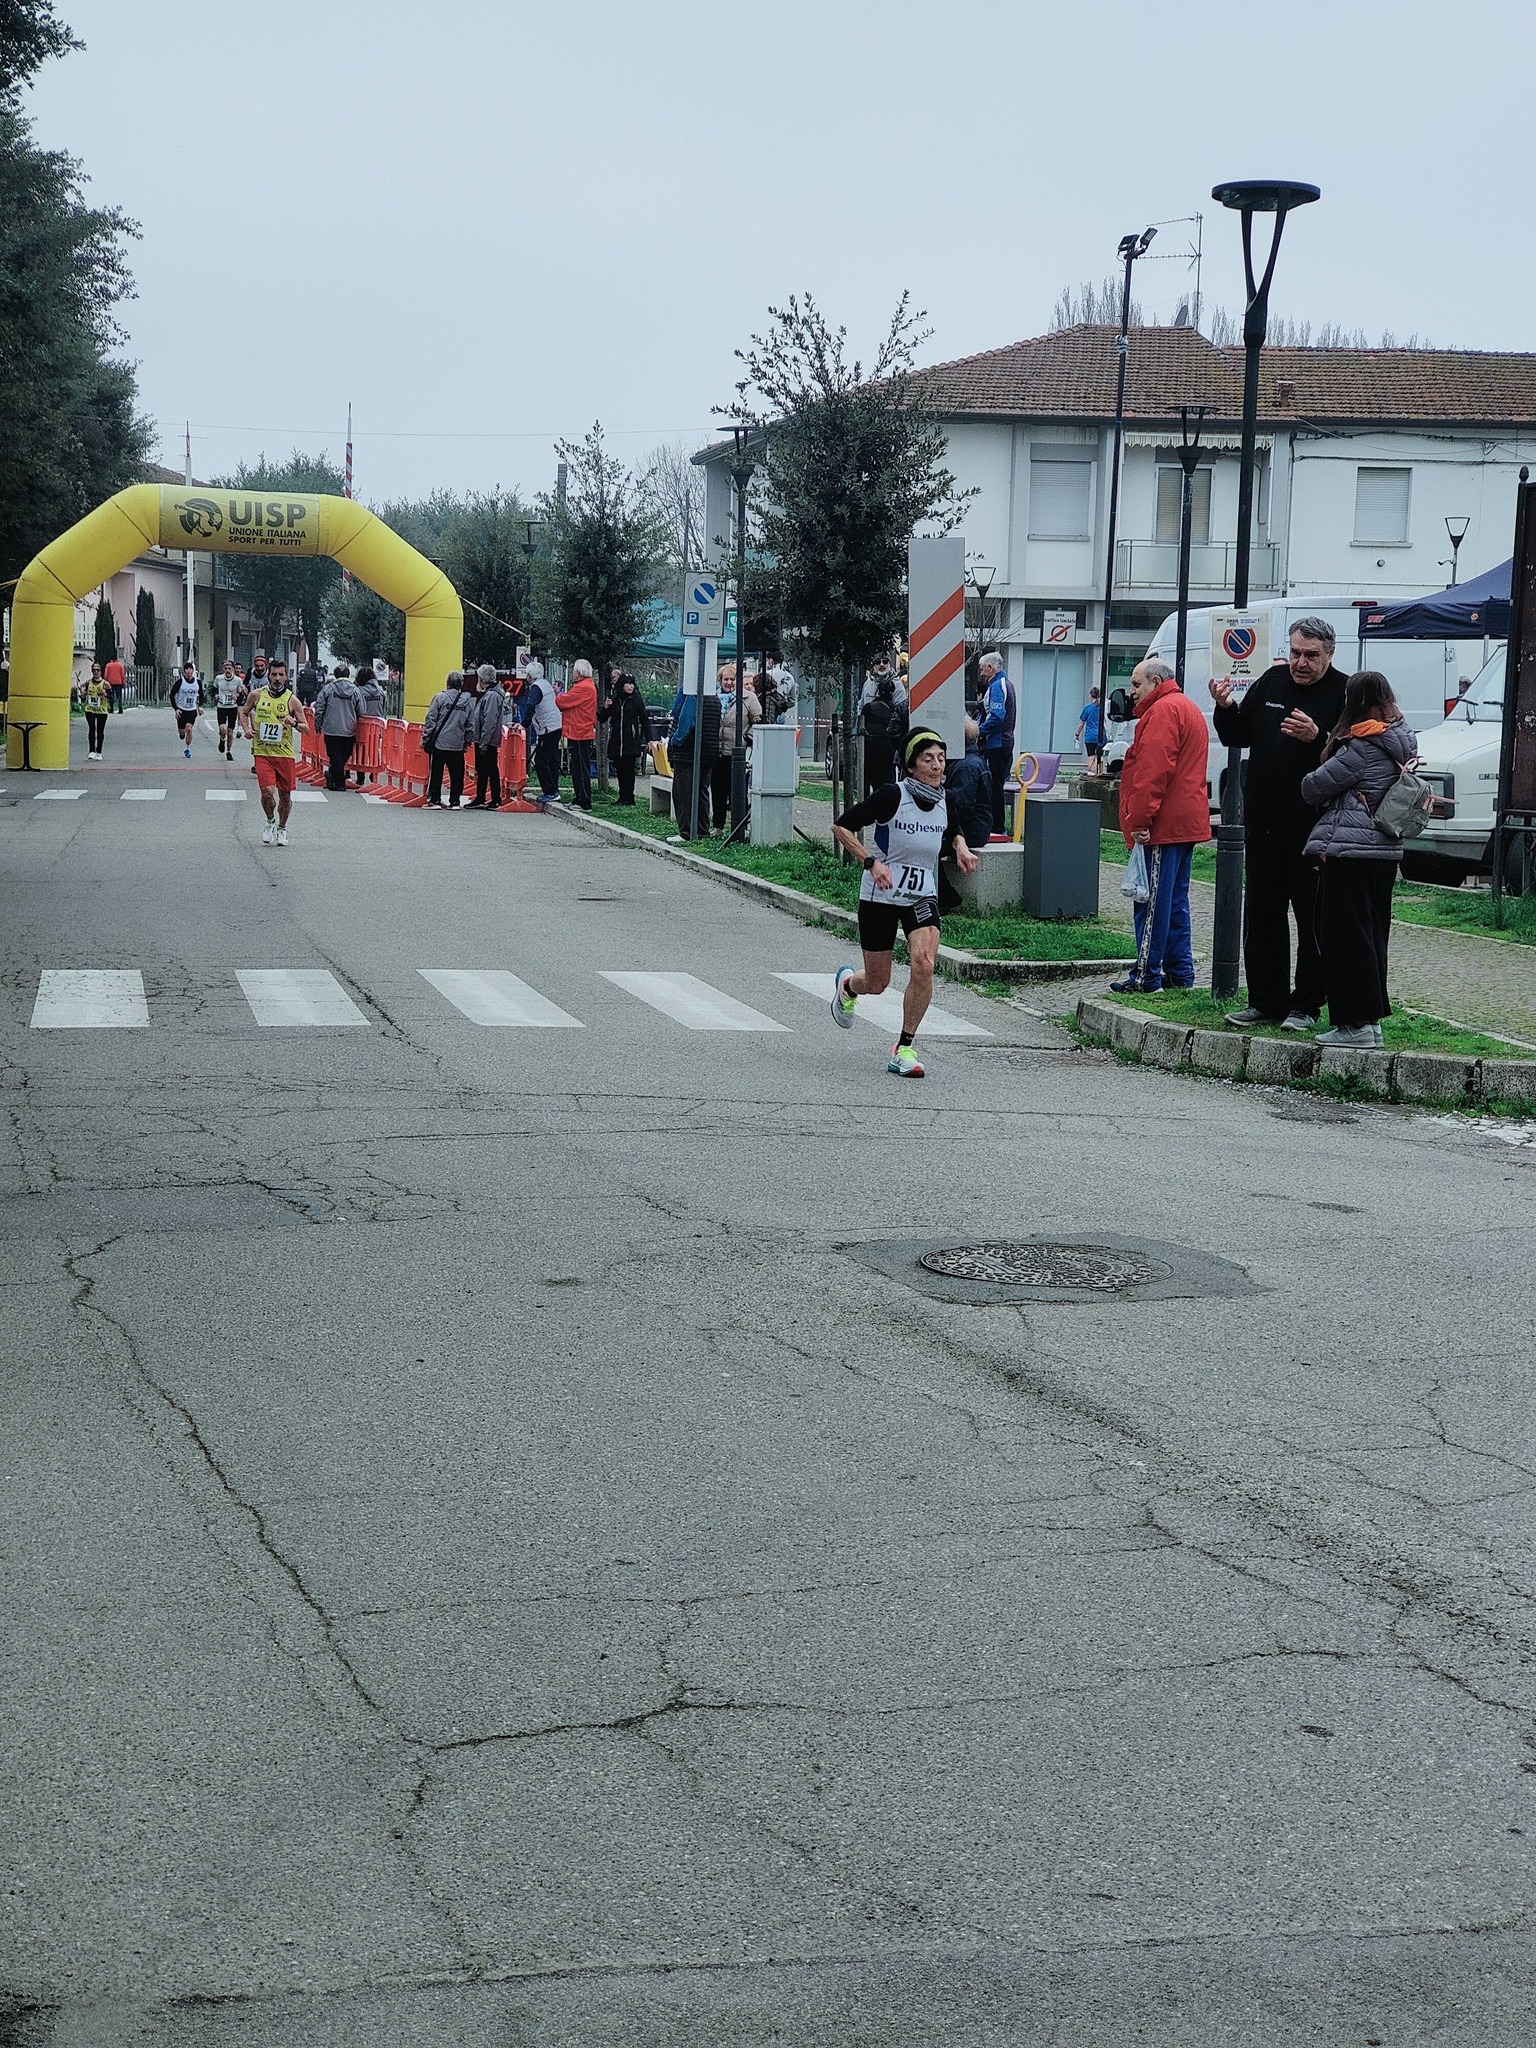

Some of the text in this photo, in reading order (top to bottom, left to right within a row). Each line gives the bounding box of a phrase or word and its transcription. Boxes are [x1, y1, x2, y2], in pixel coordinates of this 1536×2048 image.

[229, 500, 307, 528] UISP
[228, 527, 307, 539] UNIONE ITALIANA
[228, 535, 301, 546] SPORT PER TUTTI
[688, 613, 698, 624] P
[503, 680, 523, 696] 27
[264, 723, 279, 737] 722
